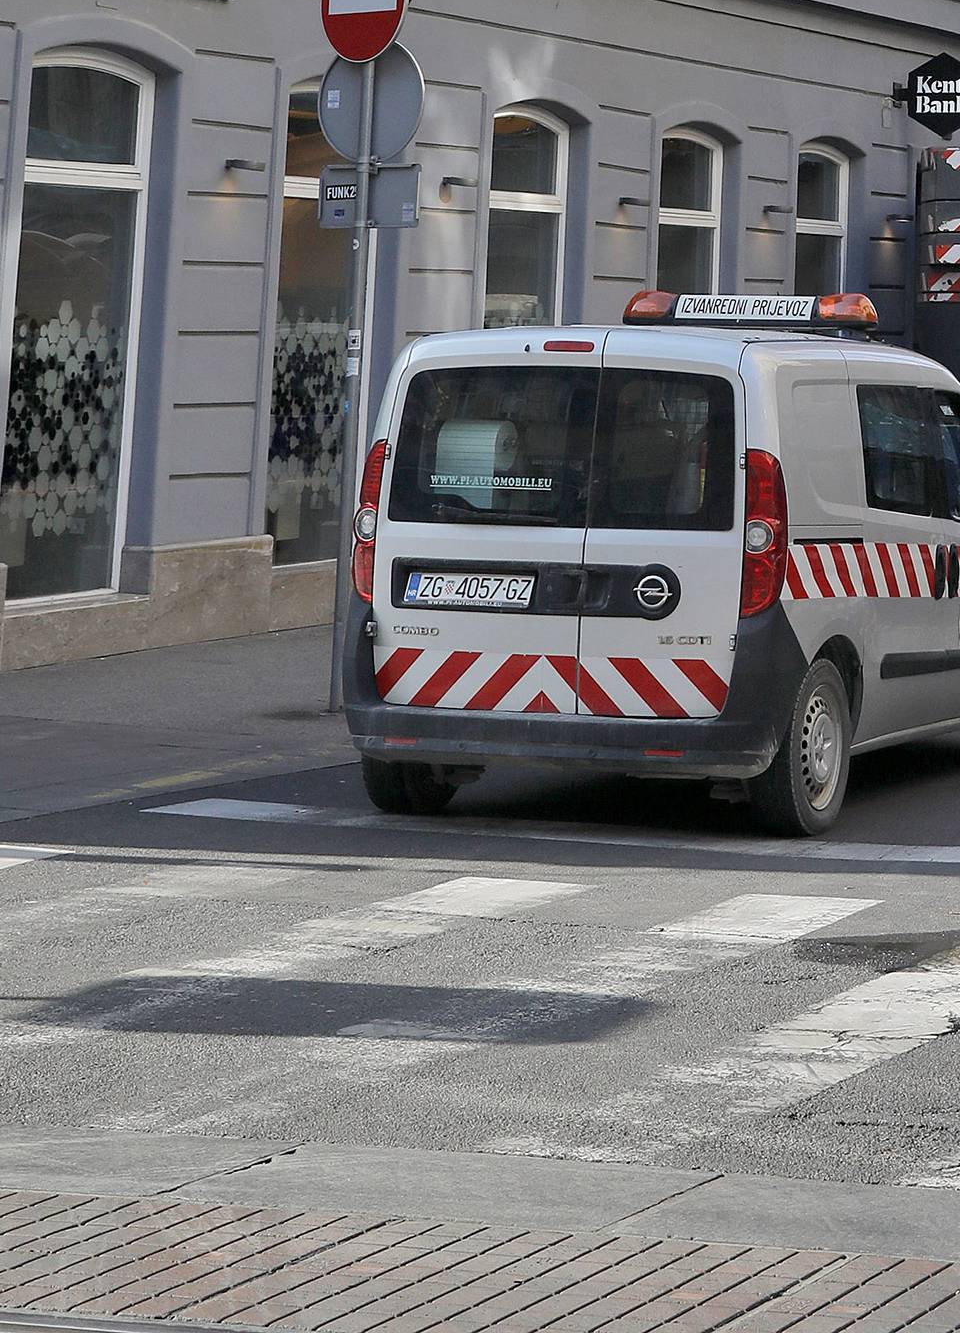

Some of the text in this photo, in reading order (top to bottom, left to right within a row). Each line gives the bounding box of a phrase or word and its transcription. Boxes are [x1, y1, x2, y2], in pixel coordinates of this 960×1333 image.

[326, 185, 357, 200] FUNK2
[681, 296, 809, 319] IZVANREDNI PRIJEVOZ
[407, 589, 418, 598] HR
[419, 575, 443, 599] ZG
[392, 625, 440, 636] COMBO
